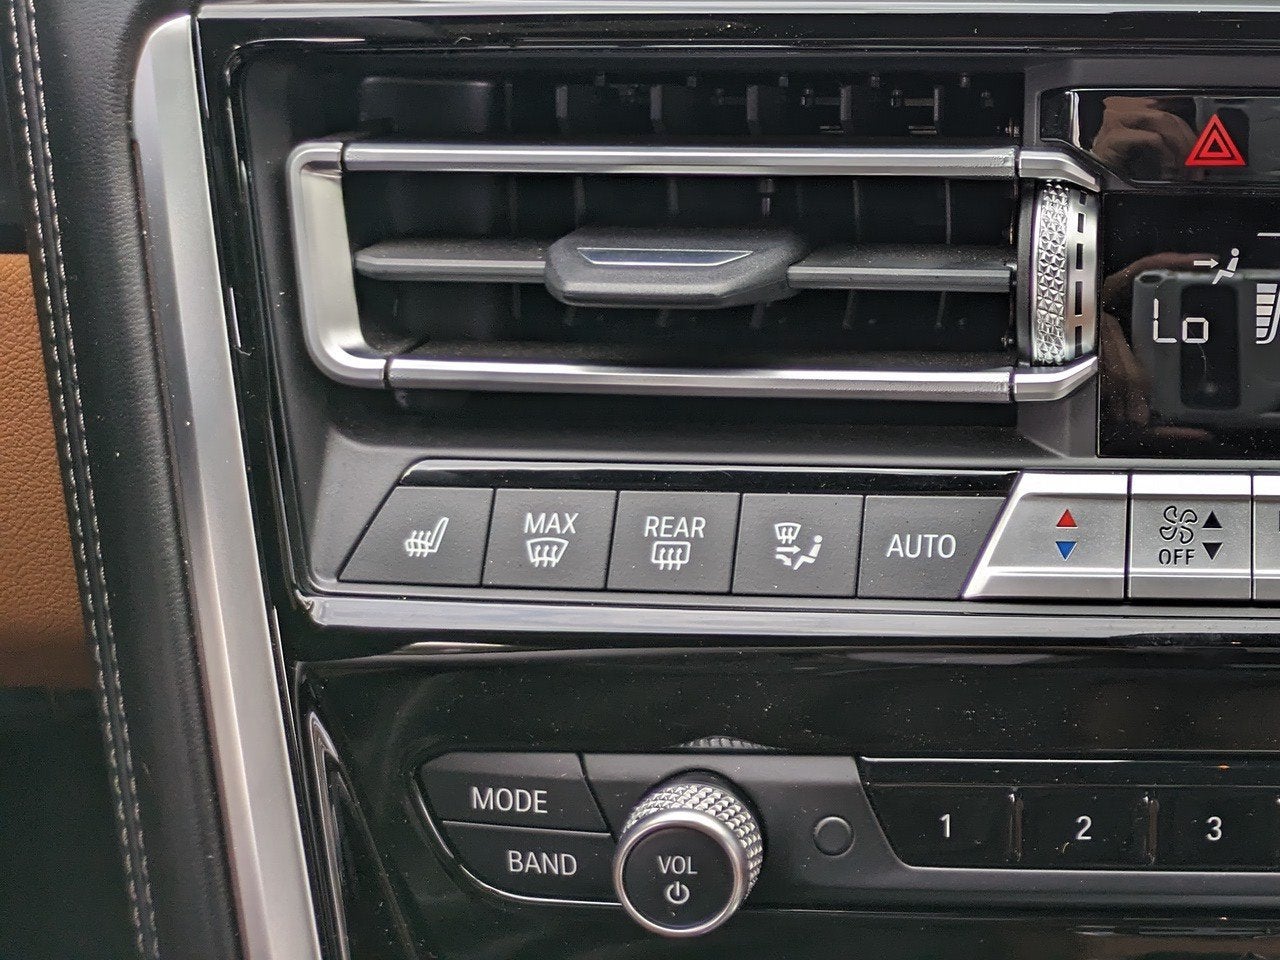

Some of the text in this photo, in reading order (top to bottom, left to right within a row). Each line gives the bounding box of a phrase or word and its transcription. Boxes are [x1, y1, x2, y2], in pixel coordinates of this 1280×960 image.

[1153, 298, 1208, 344] Lo
[523, 512, 579, 534] MAX
[643, 515, 706, 539] REAR
[886, 534, 957, 559] AUTO
[1159, 548, 1195, 566] OFF
[472, 786, 548, 815] MODE
[940, 813, 951, 839] 1
[1075, 816, 1092, 840] 2
[1206, 816, 1223, 841] 3
[507, 850, 578, 876] BAND
[658, 855, 697, 875] VOL
